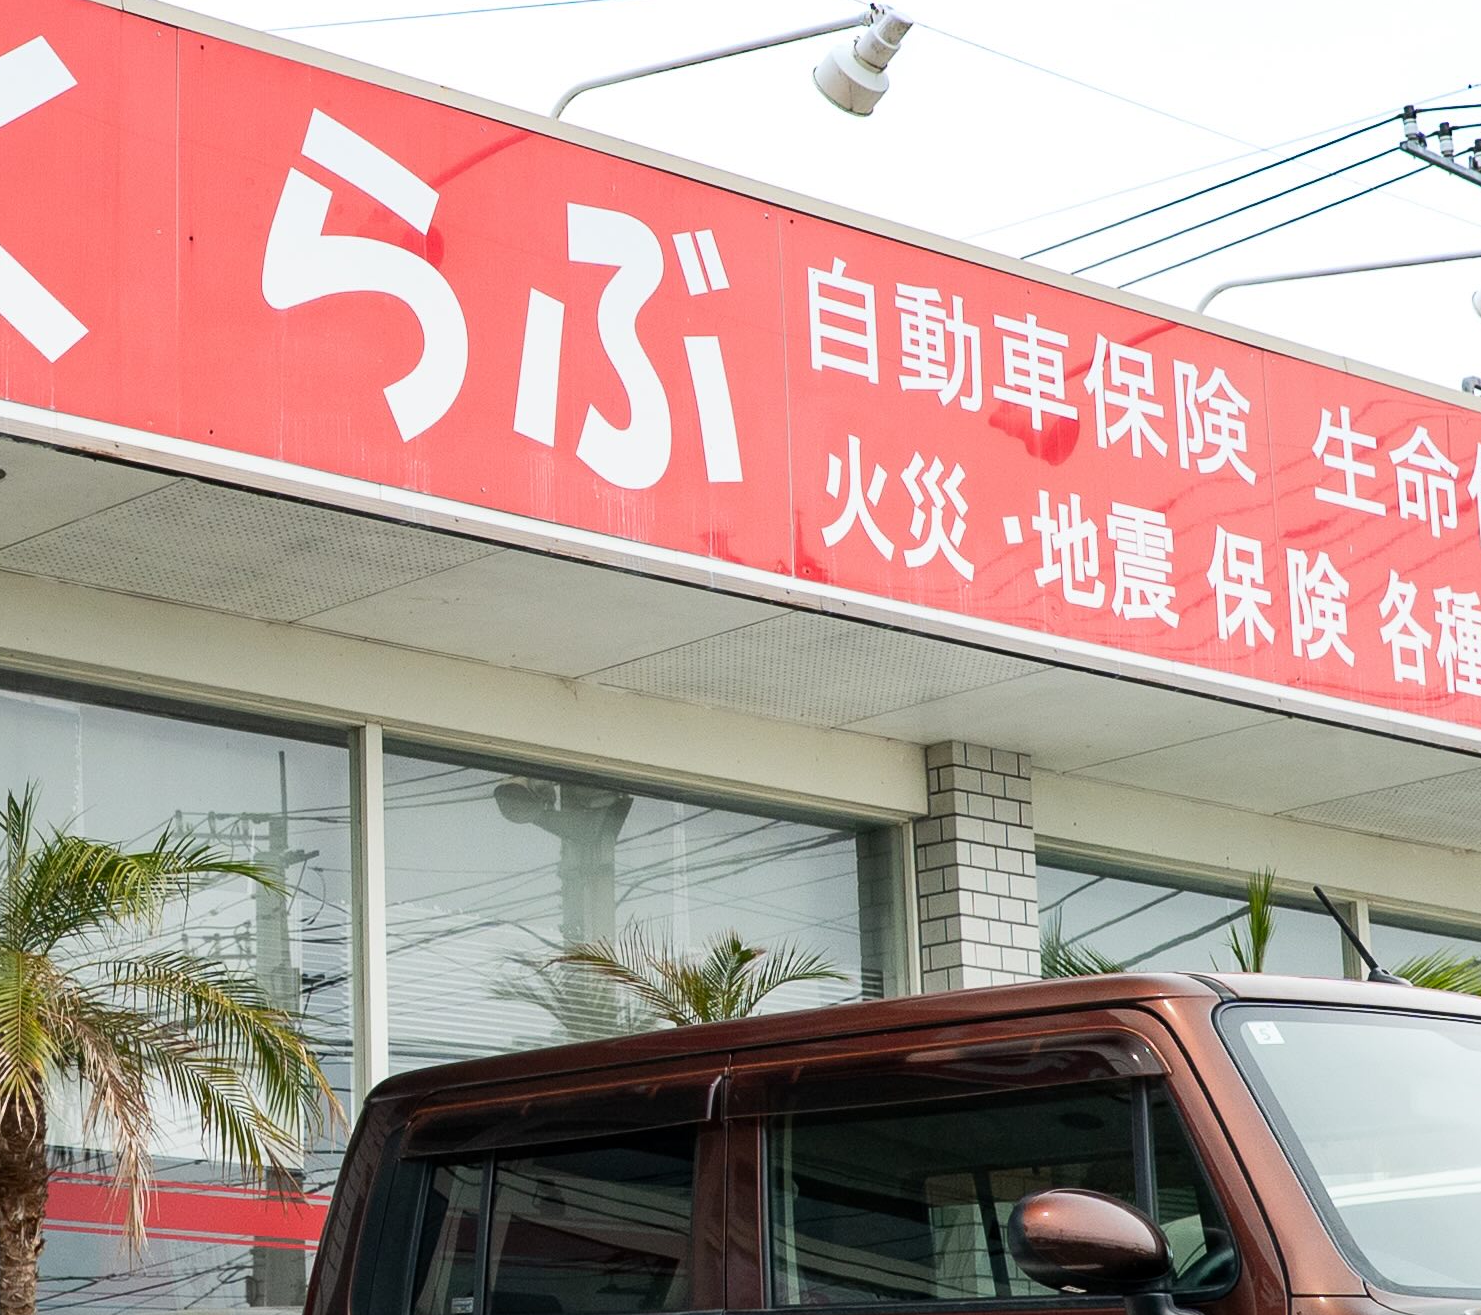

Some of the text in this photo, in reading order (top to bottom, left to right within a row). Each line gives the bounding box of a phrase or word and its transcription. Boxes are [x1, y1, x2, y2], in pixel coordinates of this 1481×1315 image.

[808, 257, 1256, 486] 自動車保険
